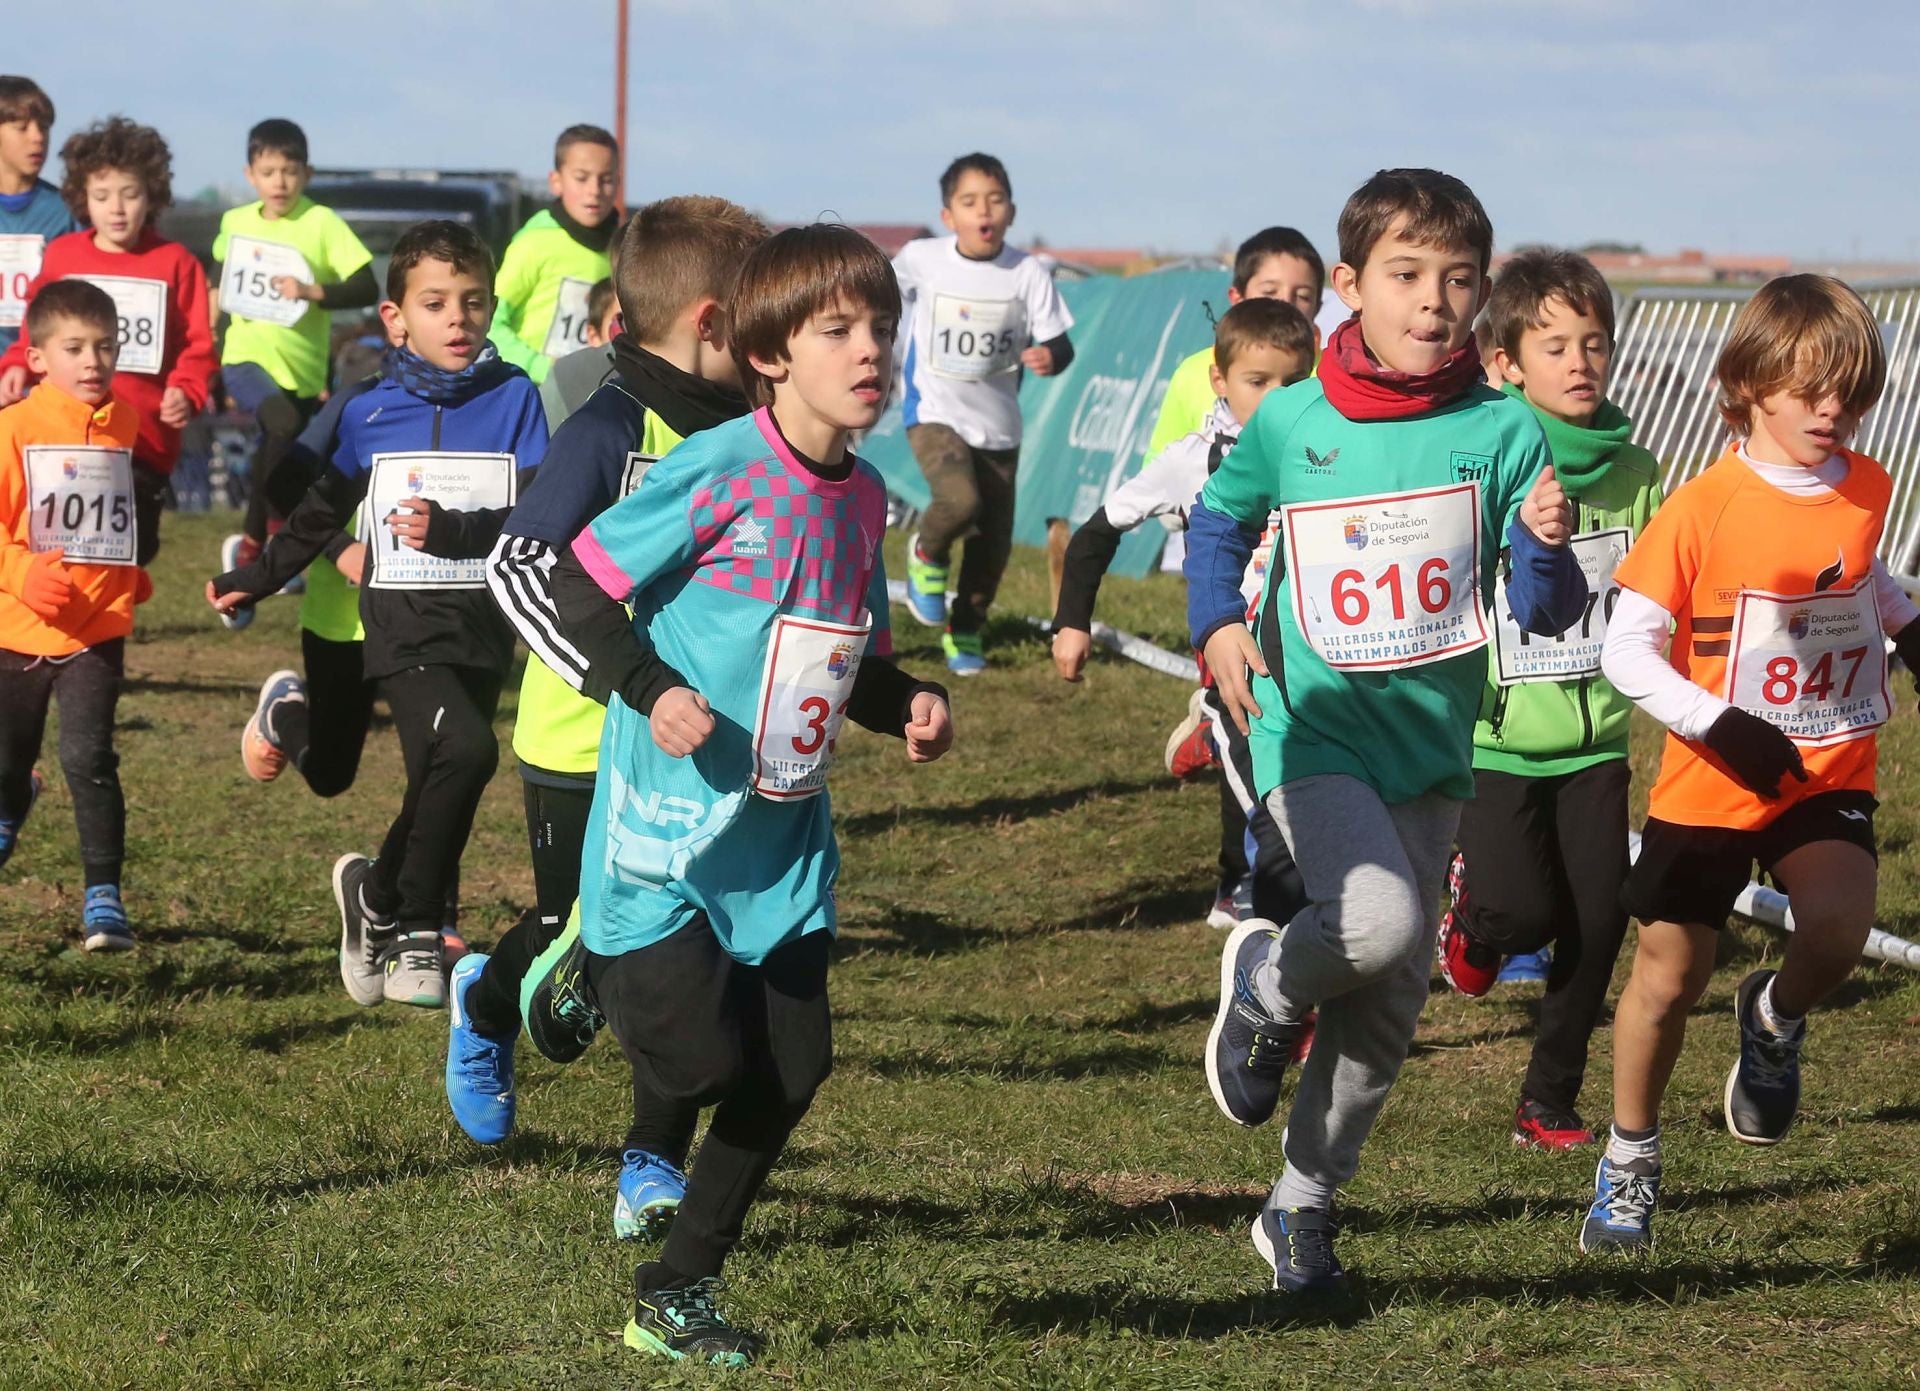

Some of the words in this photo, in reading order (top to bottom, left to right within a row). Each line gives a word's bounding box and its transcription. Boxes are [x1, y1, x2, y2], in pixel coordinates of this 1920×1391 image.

[232, 268, 298, 304] 159
[939, 328, 1014, 357] 1035
[425, 472, 470, 483] Diputación
[438, 484, 470, 492] Segovia
[40, 492, 129, 533] 1015
[1370, 516, 1428, 534] Diputación
[1372, 536, 1385, 546] de
[1389, 530, 1430, 545] Segovia
[733, 545, 767, 555] luanvi
[387, 569, 458, 579] CANTIMPALOS
[1330, 557, 1451, 626] 616
[1811, 612, 1861, 625] Diputación
[1323, 636, 1340, 646] LII
[1344, 634, 1384, 645] CROSS
[1388, 622, 1448, 641] NACIONAL
[1450, 615, 1464, 627] DE
[1810, 628, 1823, 637] de
[1825, 624, 1860, 637] Segovia
[1326, 640, 1427, 661] CANTIMPALOS
[1436, 630, 1468, 647] 2024
[1513, 651, 1528, 660] LII
[1531, 649, 1565, 659] CROSS
[1568, 643, 1604, 657] NACION
[1514, 657, 1598, 673] CANTIMPALOS
[1762, 645, 1868, 706] 847
[1766, 710, 1804, 722] CROSS
[1807, 701, 1858, 721] NACIONAL
[1860, 698, 1873, 710] DE
[1845, 711, 1878, 727] 2024
[772, 760, 788, 772] LII
